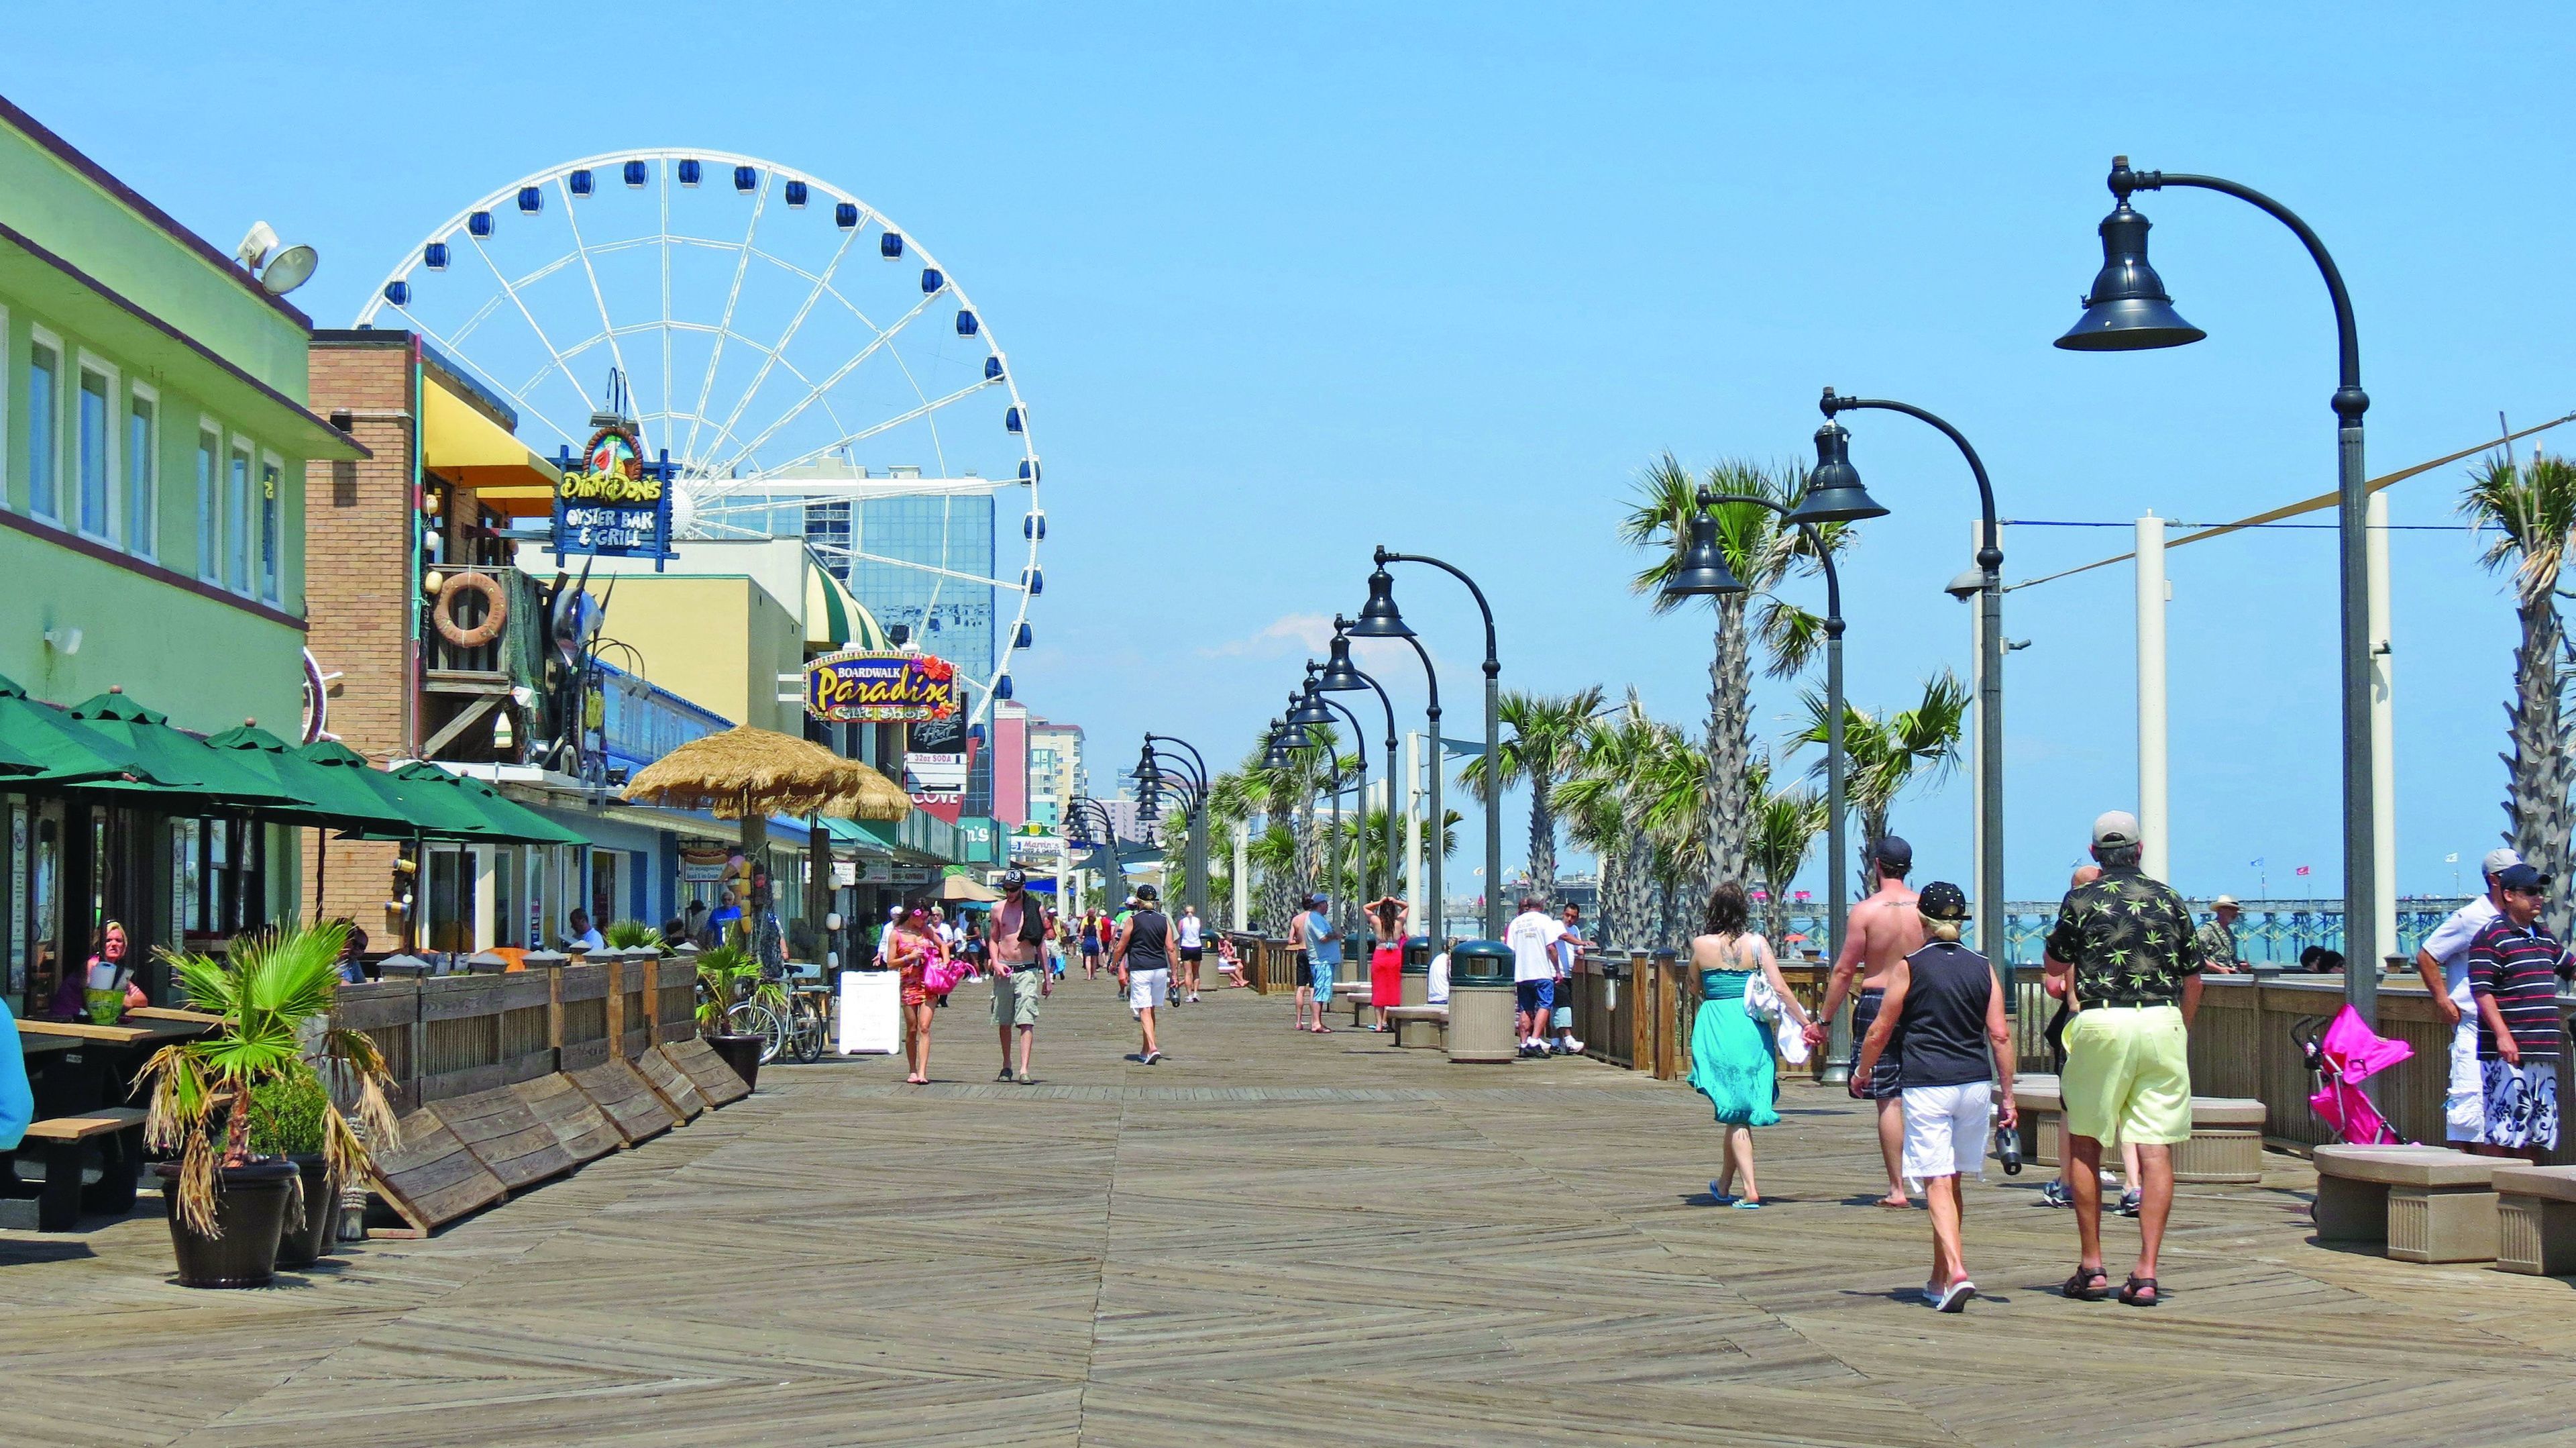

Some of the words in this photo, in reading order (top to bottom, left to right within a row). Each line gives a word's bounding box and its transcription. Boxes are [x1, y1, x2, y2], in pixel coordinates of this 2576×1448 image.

[566, 508, 616, 526] OYSTER
[621, 511, 654, 529] BAR
[578, 527, 592, 546] &
[595, 528, 641, 546] GRILL
[838, 668, 901, 678] BOARDWALK
[817, 664, 949, 711] Paradise
[880, 706, 928, 720] Shop
[914, 754, 931, 763] 32oz
[932, 755, 951, 763] SODA
